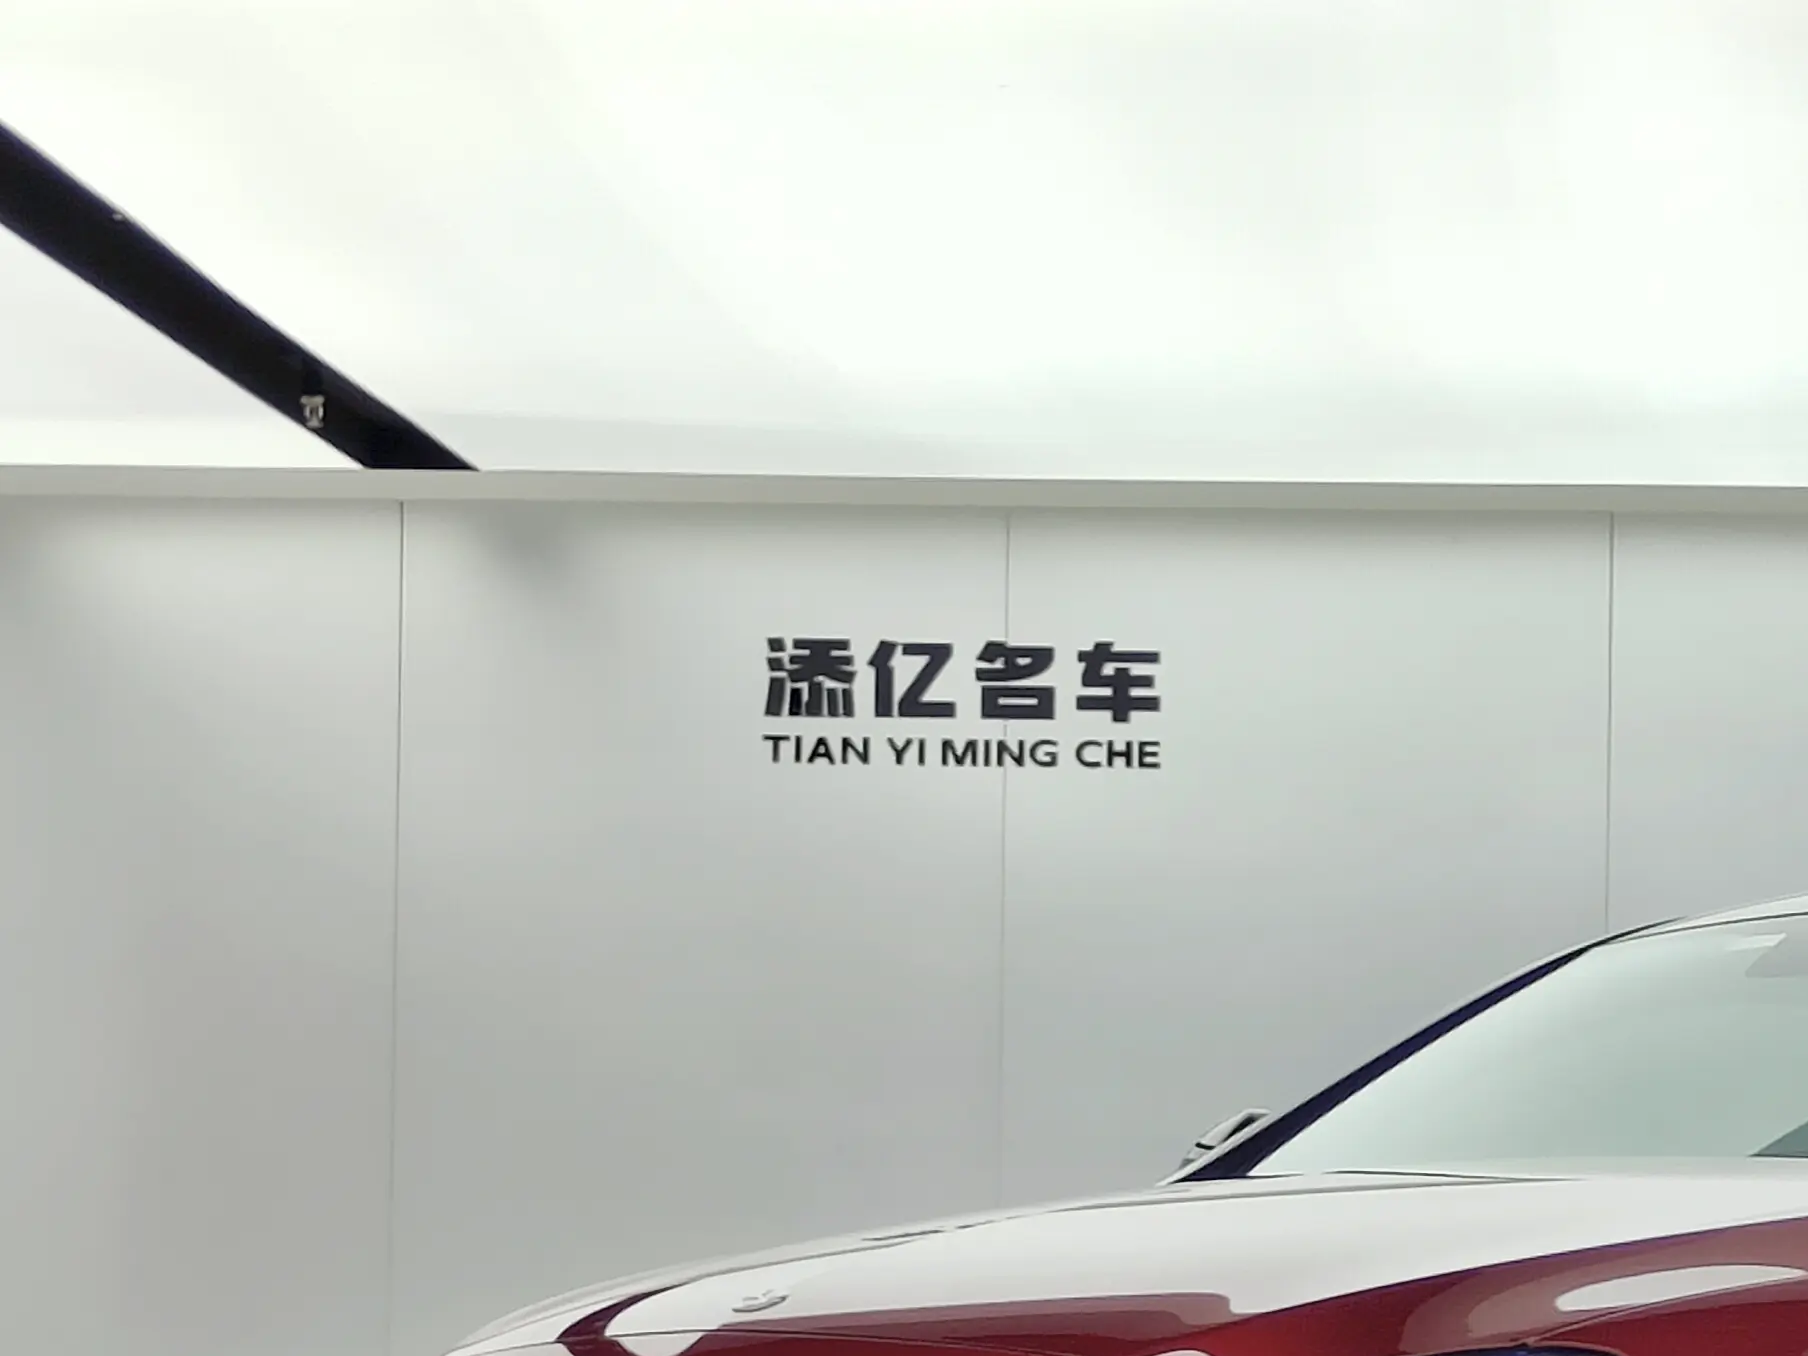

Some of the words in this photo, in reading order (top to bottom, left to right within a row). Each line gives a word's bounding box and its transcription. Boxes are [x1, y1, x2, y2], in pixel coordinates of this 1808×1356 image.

[765, 637, 1161, 723] 添亿名车
[763, 735, 871, 765] TIAN
[886, 737, 926, 766] YI
[941, 738, 1059, 768] MING
[1075, 739, 1161, 769] CHE
